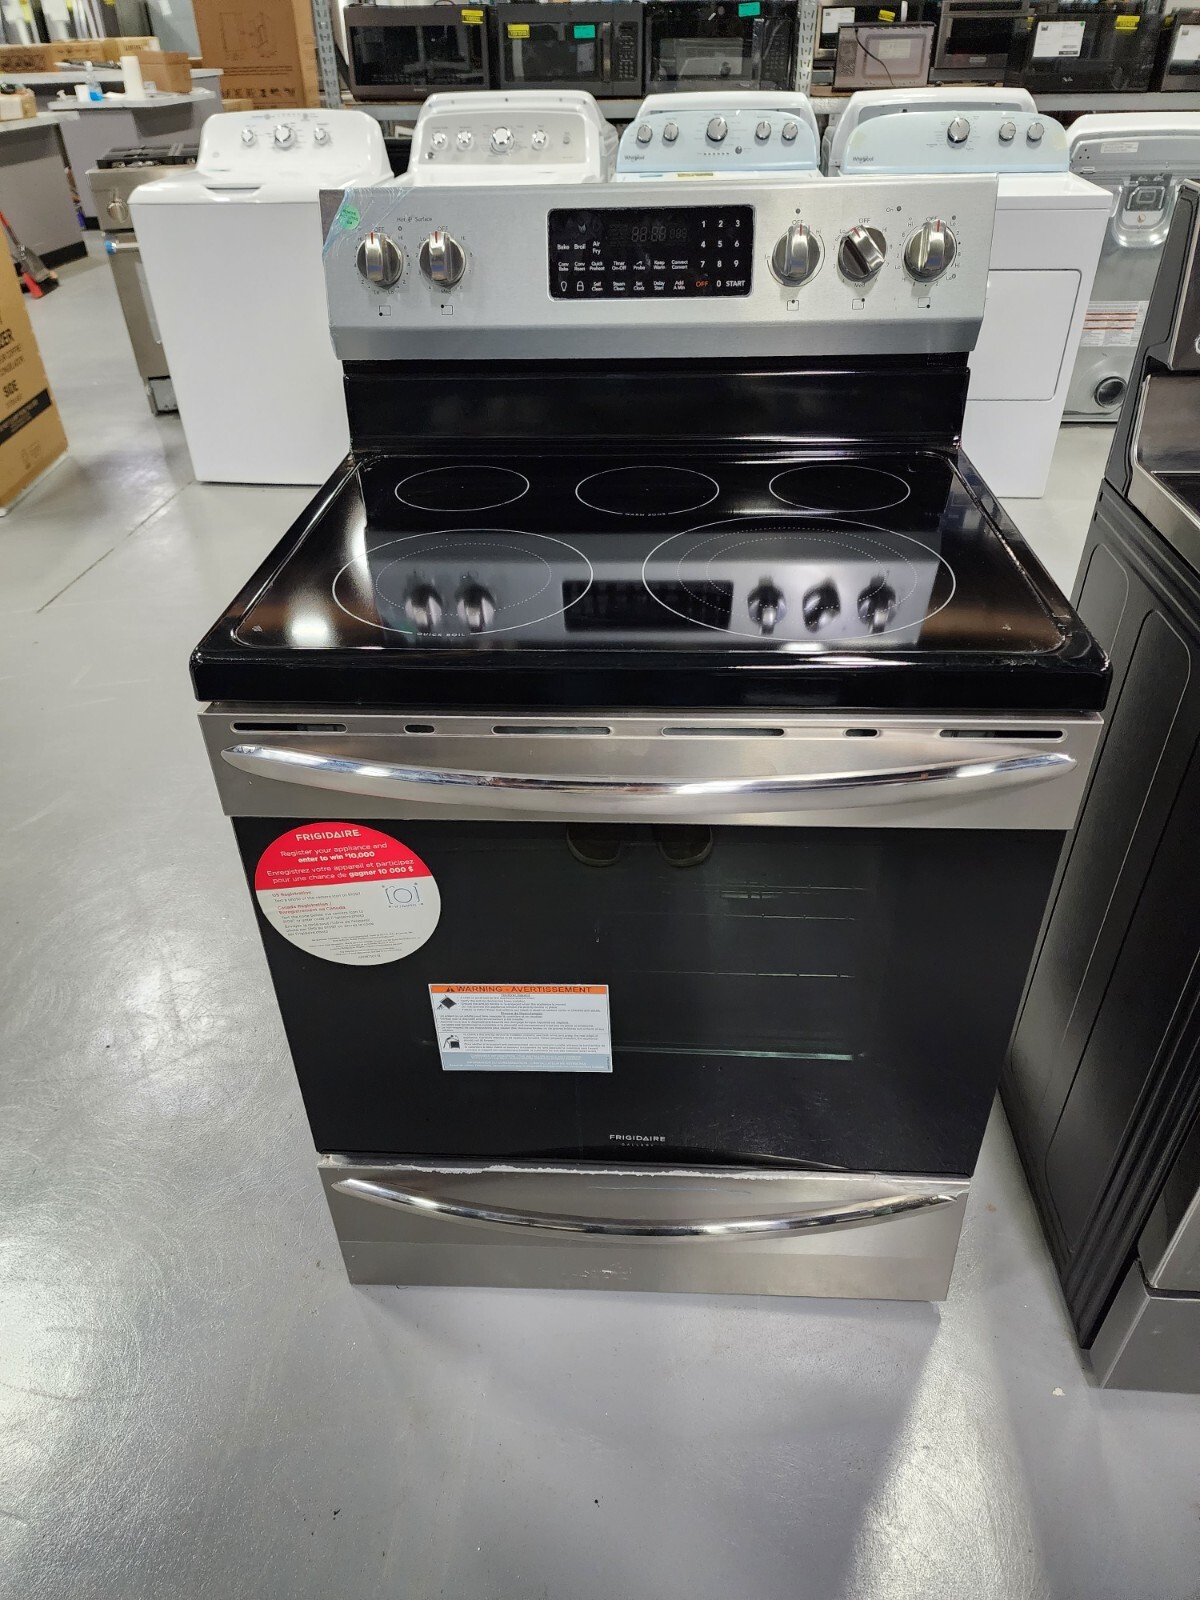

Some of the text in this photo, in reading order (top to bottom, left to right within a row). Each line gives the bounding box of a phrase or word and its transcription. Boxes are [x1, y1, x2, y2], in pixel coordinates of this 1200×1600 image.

[295, 829, 361, 841] FRIGIDAIRE
[280, 848, 312, 857] Register
[333, 844, 371, 855] appliance
[266, 868, 310, 877] Enregistrez
[333, 863, 364, 873] appareil
[375, 859, 414, 869] participez
[308, 872, 335, 881] chance
[349, 870, 376, 878] gagner
